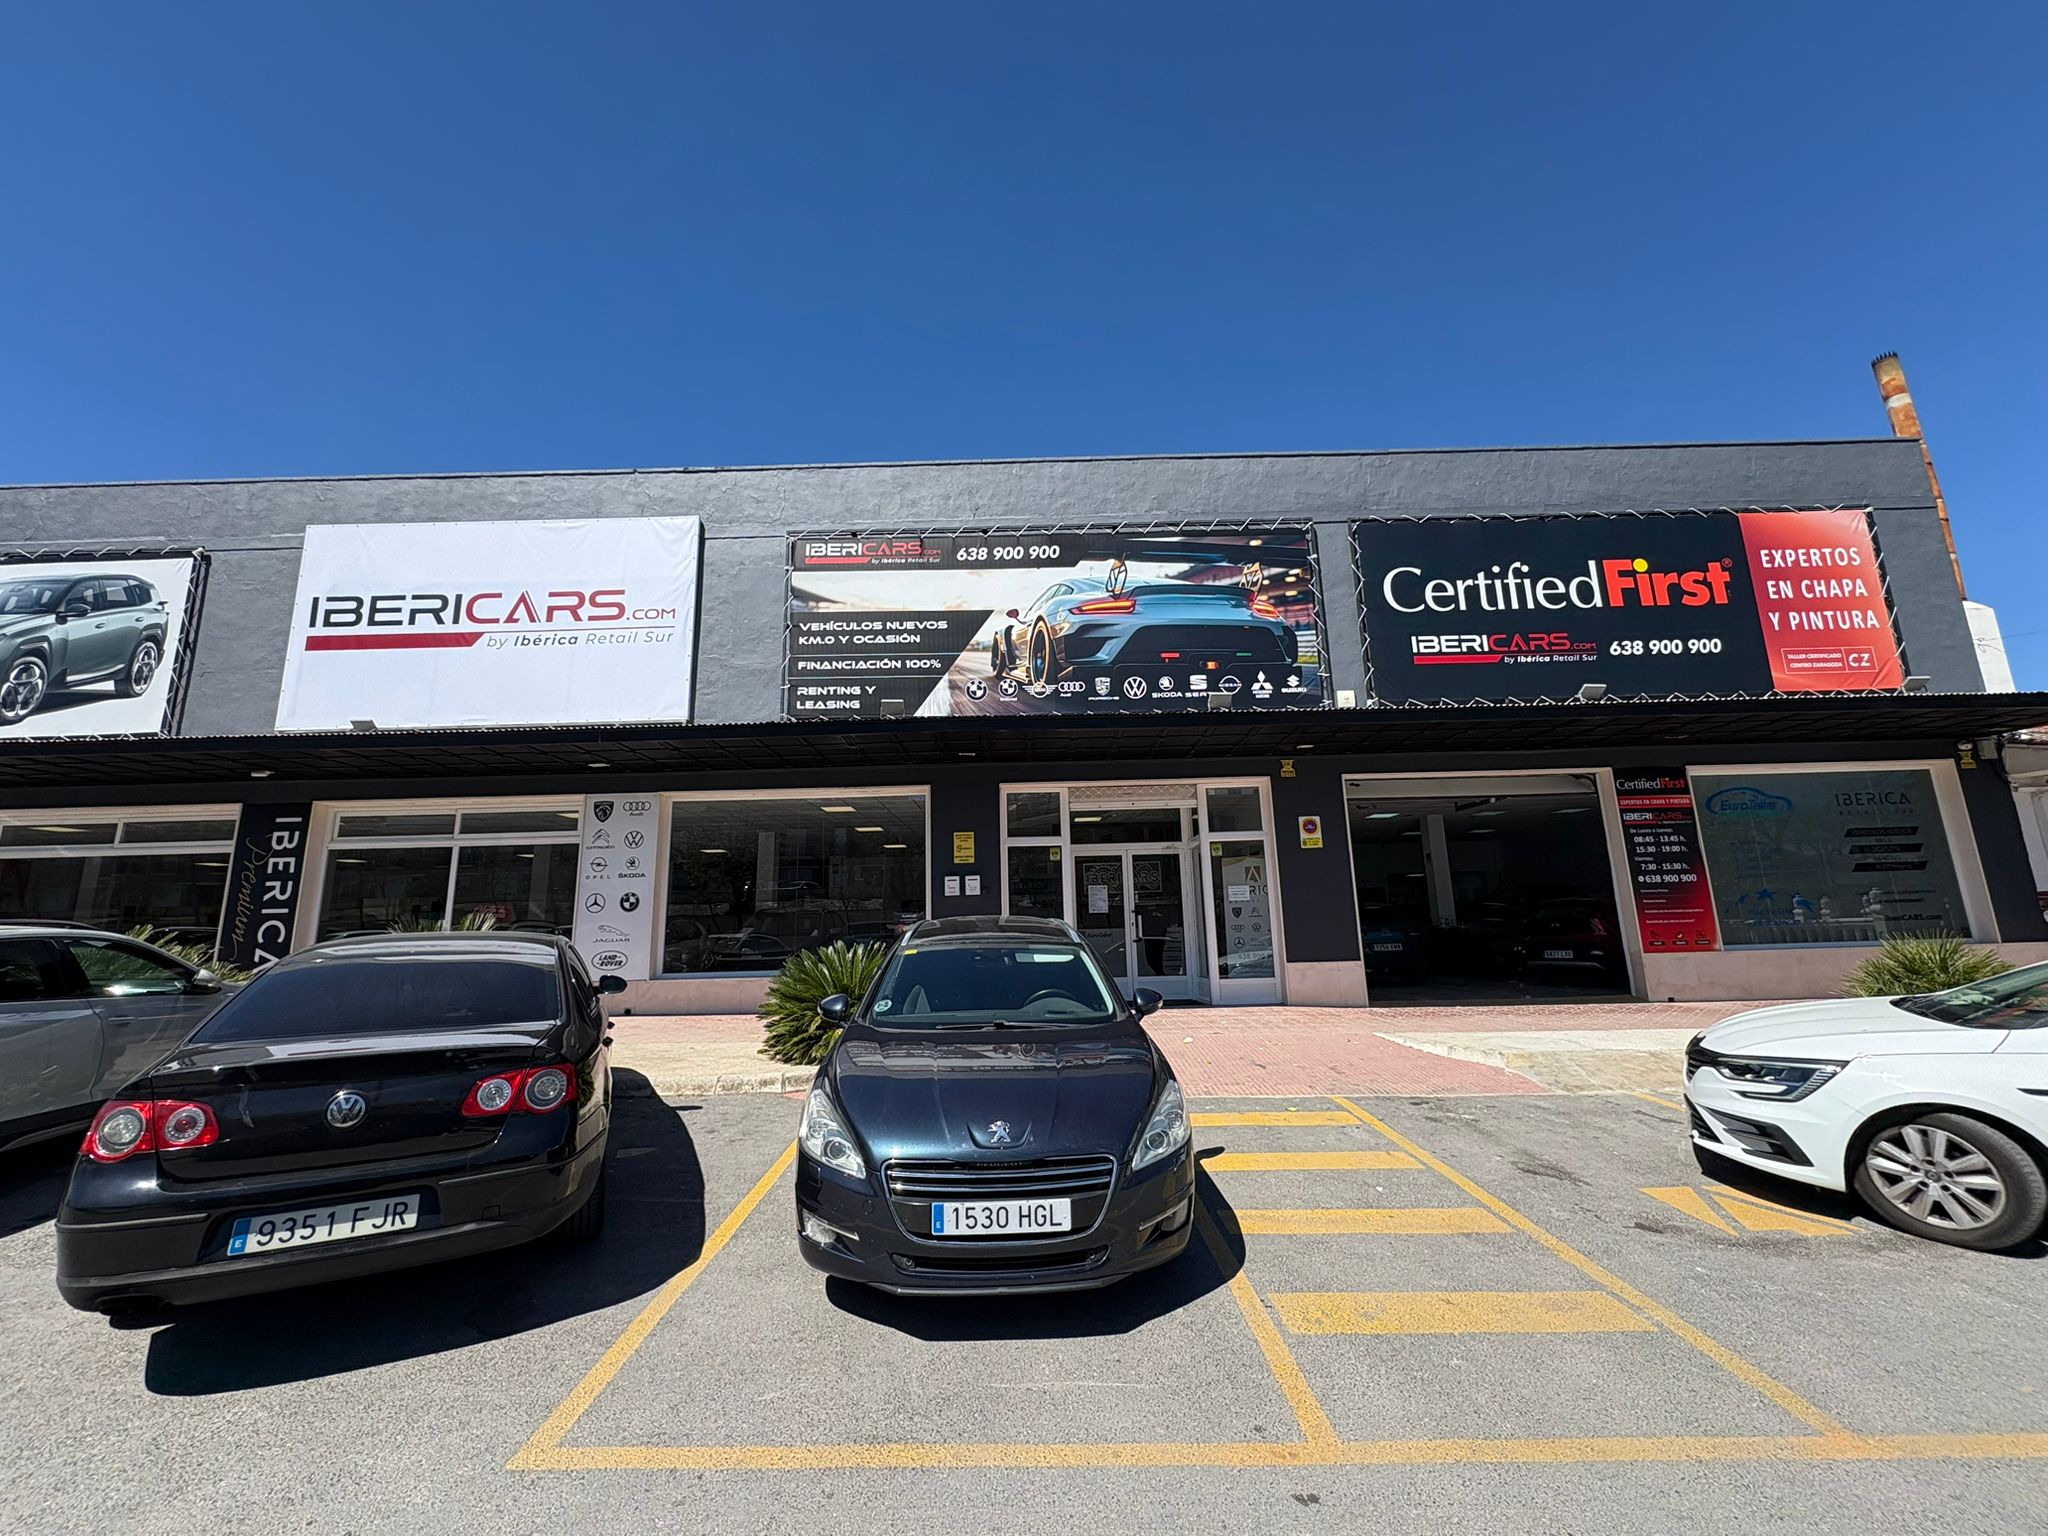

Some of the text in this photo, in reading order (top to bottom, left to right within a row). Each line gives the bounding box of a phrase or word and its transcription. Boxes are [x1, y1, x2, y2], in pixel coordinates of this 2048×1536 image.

[957, 545, 1060, 561] 638 900 900
[1759, 546, 1861, 569] EXPERTOS
[1766, 578, 1869, 600] EN CHAPA
[799, 620, 948, 631] VEHÍCULOS NUEVOS
[1767, 609, 1880, 632] Y PINTURA
[486, 630, 674, 649] by Ibérica Retail Sur
[838, 635, 850, 644] Y
[853, 633, 921, 644] OCASIÓN
[1609, 638, 1722, 656] 638 900 900
[798, 657, 942, 671] FINANCIACIÓN 100%
[1504, 653, 1597, 664] by Ibérica Retail Sur
[1848, 653, 1871, 667] CZ
[797, 685, 876, 696] RENTING Y
[796, 700, 861, 710] LEASING
[1834, 791, 1912, 806] IBERICA
[1645, 874, 1697, 883] 638 900 900
[253, 817, 303, 974] IBERICA
[936, 1203, 1063, 1230] E 1530 HGL
[234, 1201, 409, 1248] E 9351 FJR
